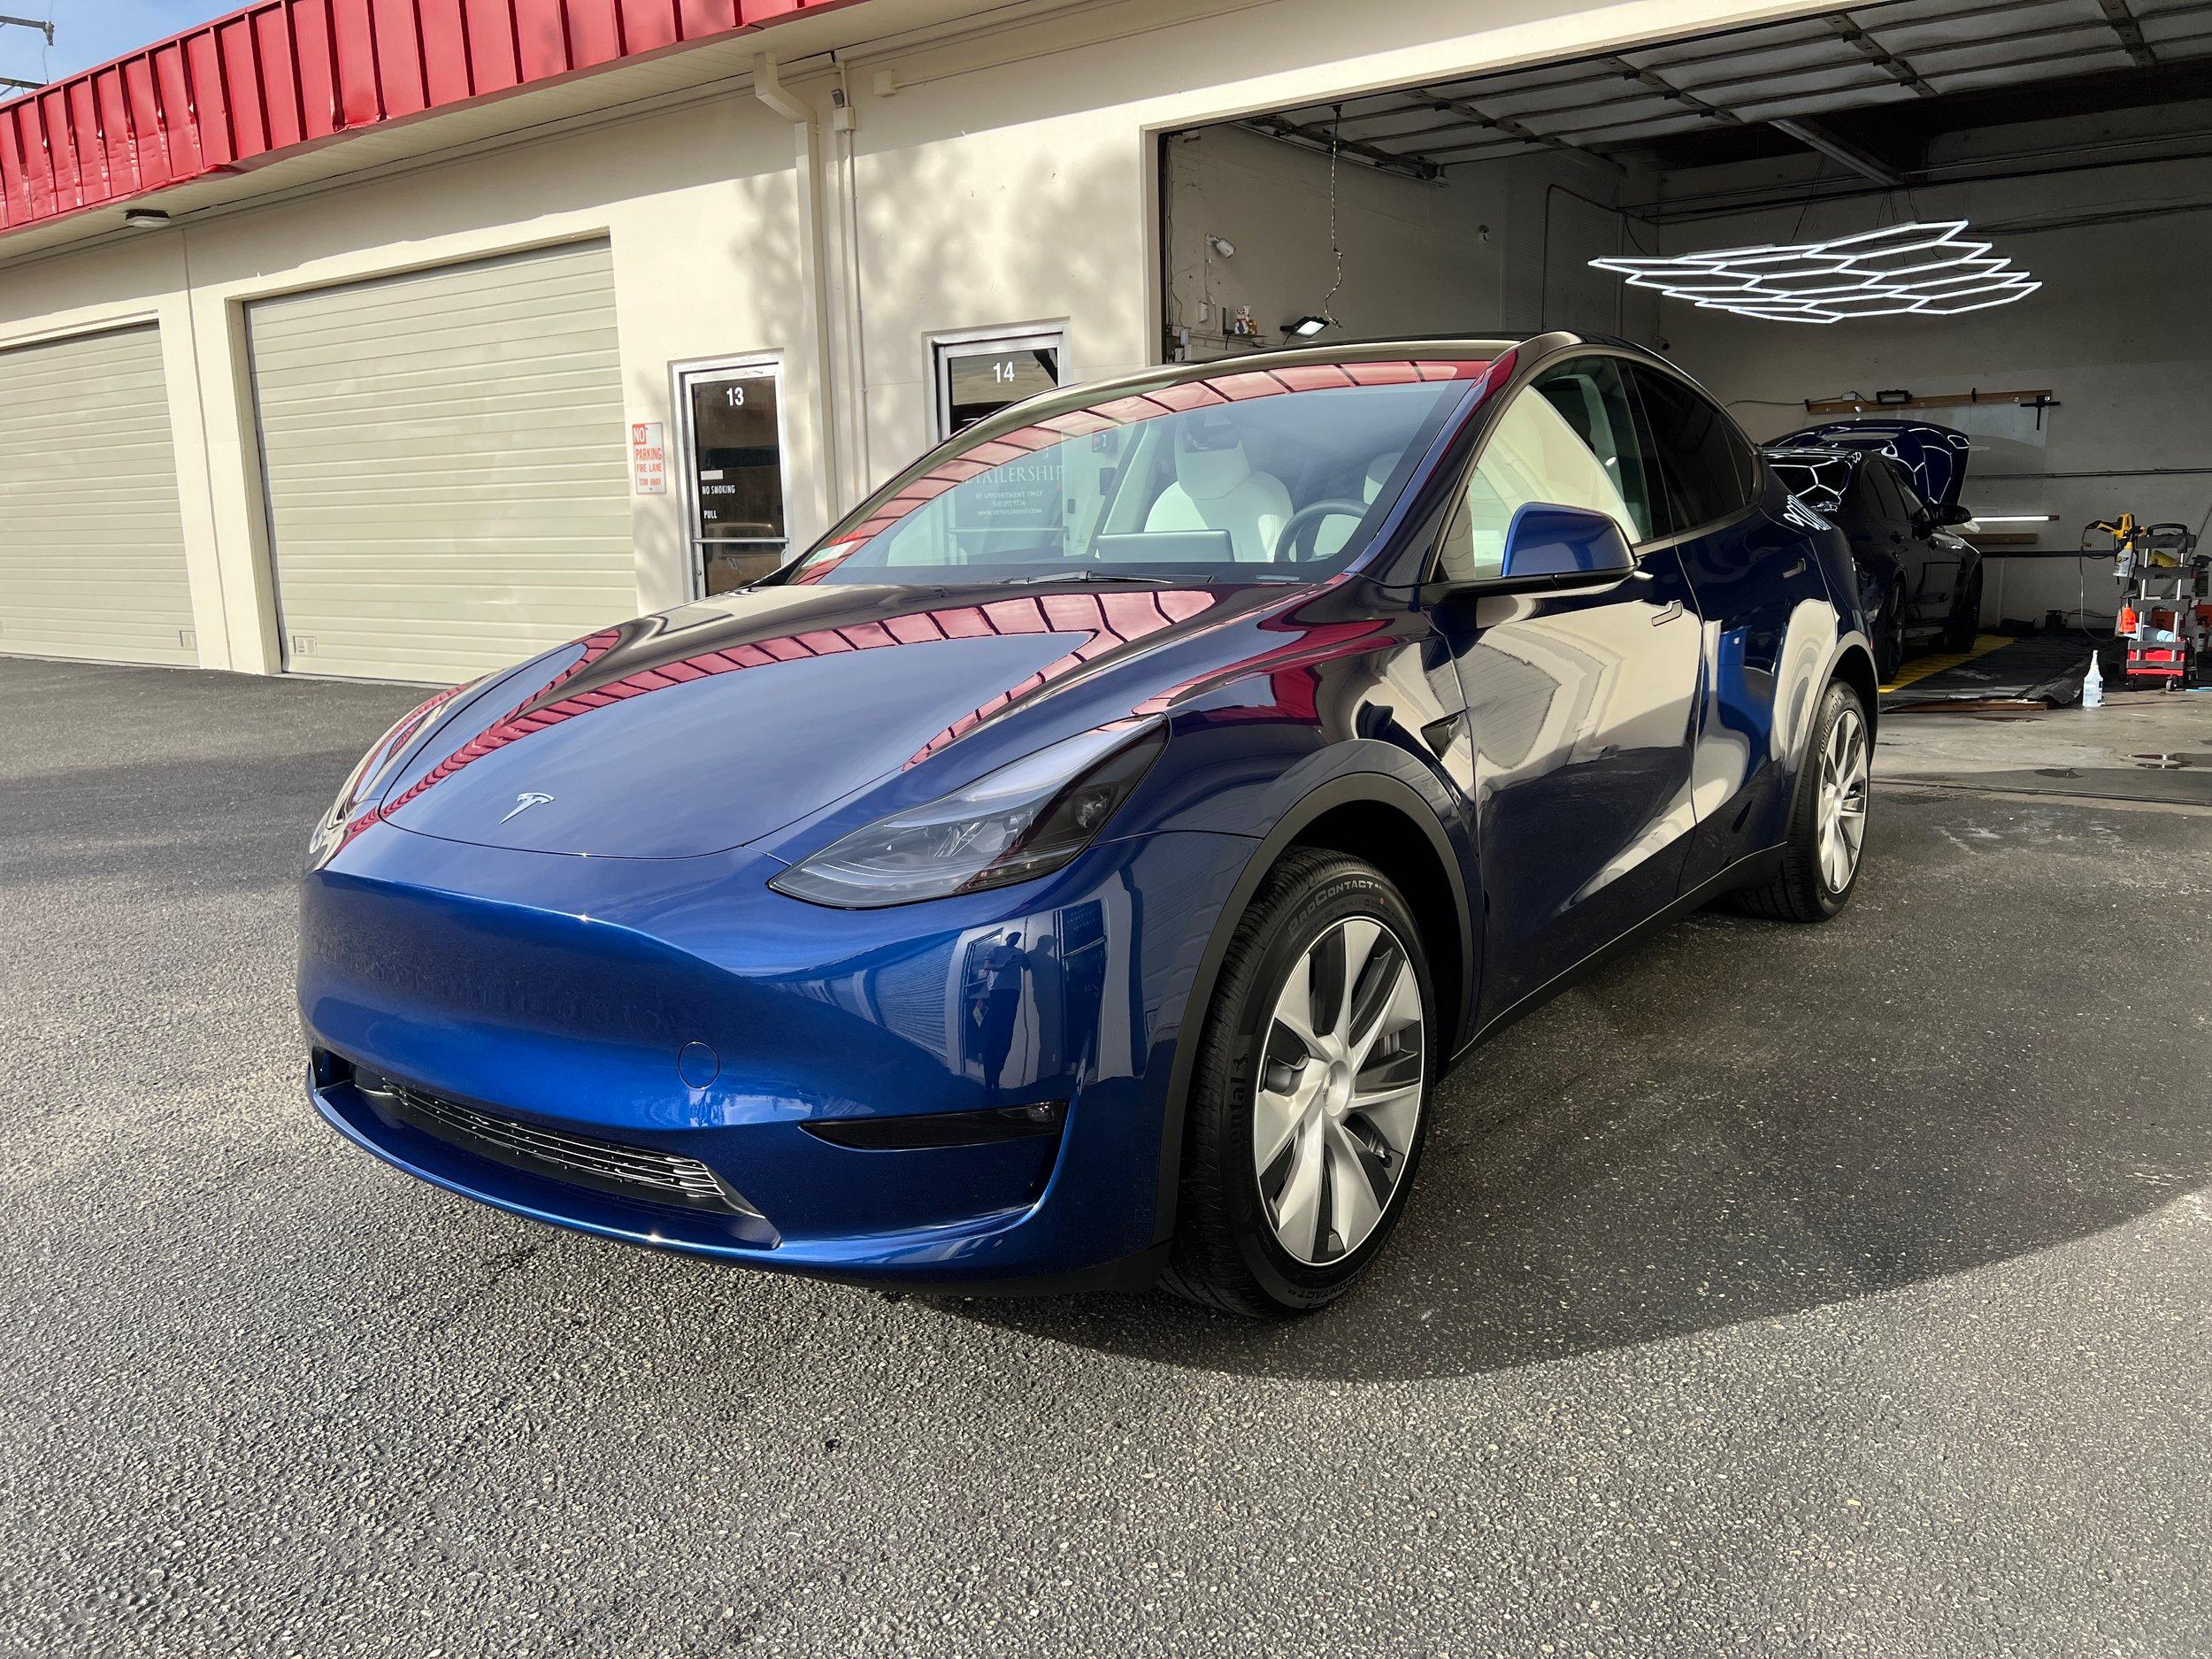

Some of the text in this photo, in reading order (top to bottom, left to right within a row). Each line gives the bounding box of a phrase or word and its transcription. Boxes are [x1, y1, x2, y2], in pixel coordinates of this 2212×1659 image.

[993, 361, 1015, 383] 14
[726, 387, 744, 406] 13
[633, 426, 645, 442] NO
[635, 448, 662, 460] PARKING
[637, 463, 662, 472] FIRE LANE
[964, 465, 1063, 484] TAILERSHIP
[702, 485, 735, 495] NO SMOKING
[703, 510, 718, 519] PULL
